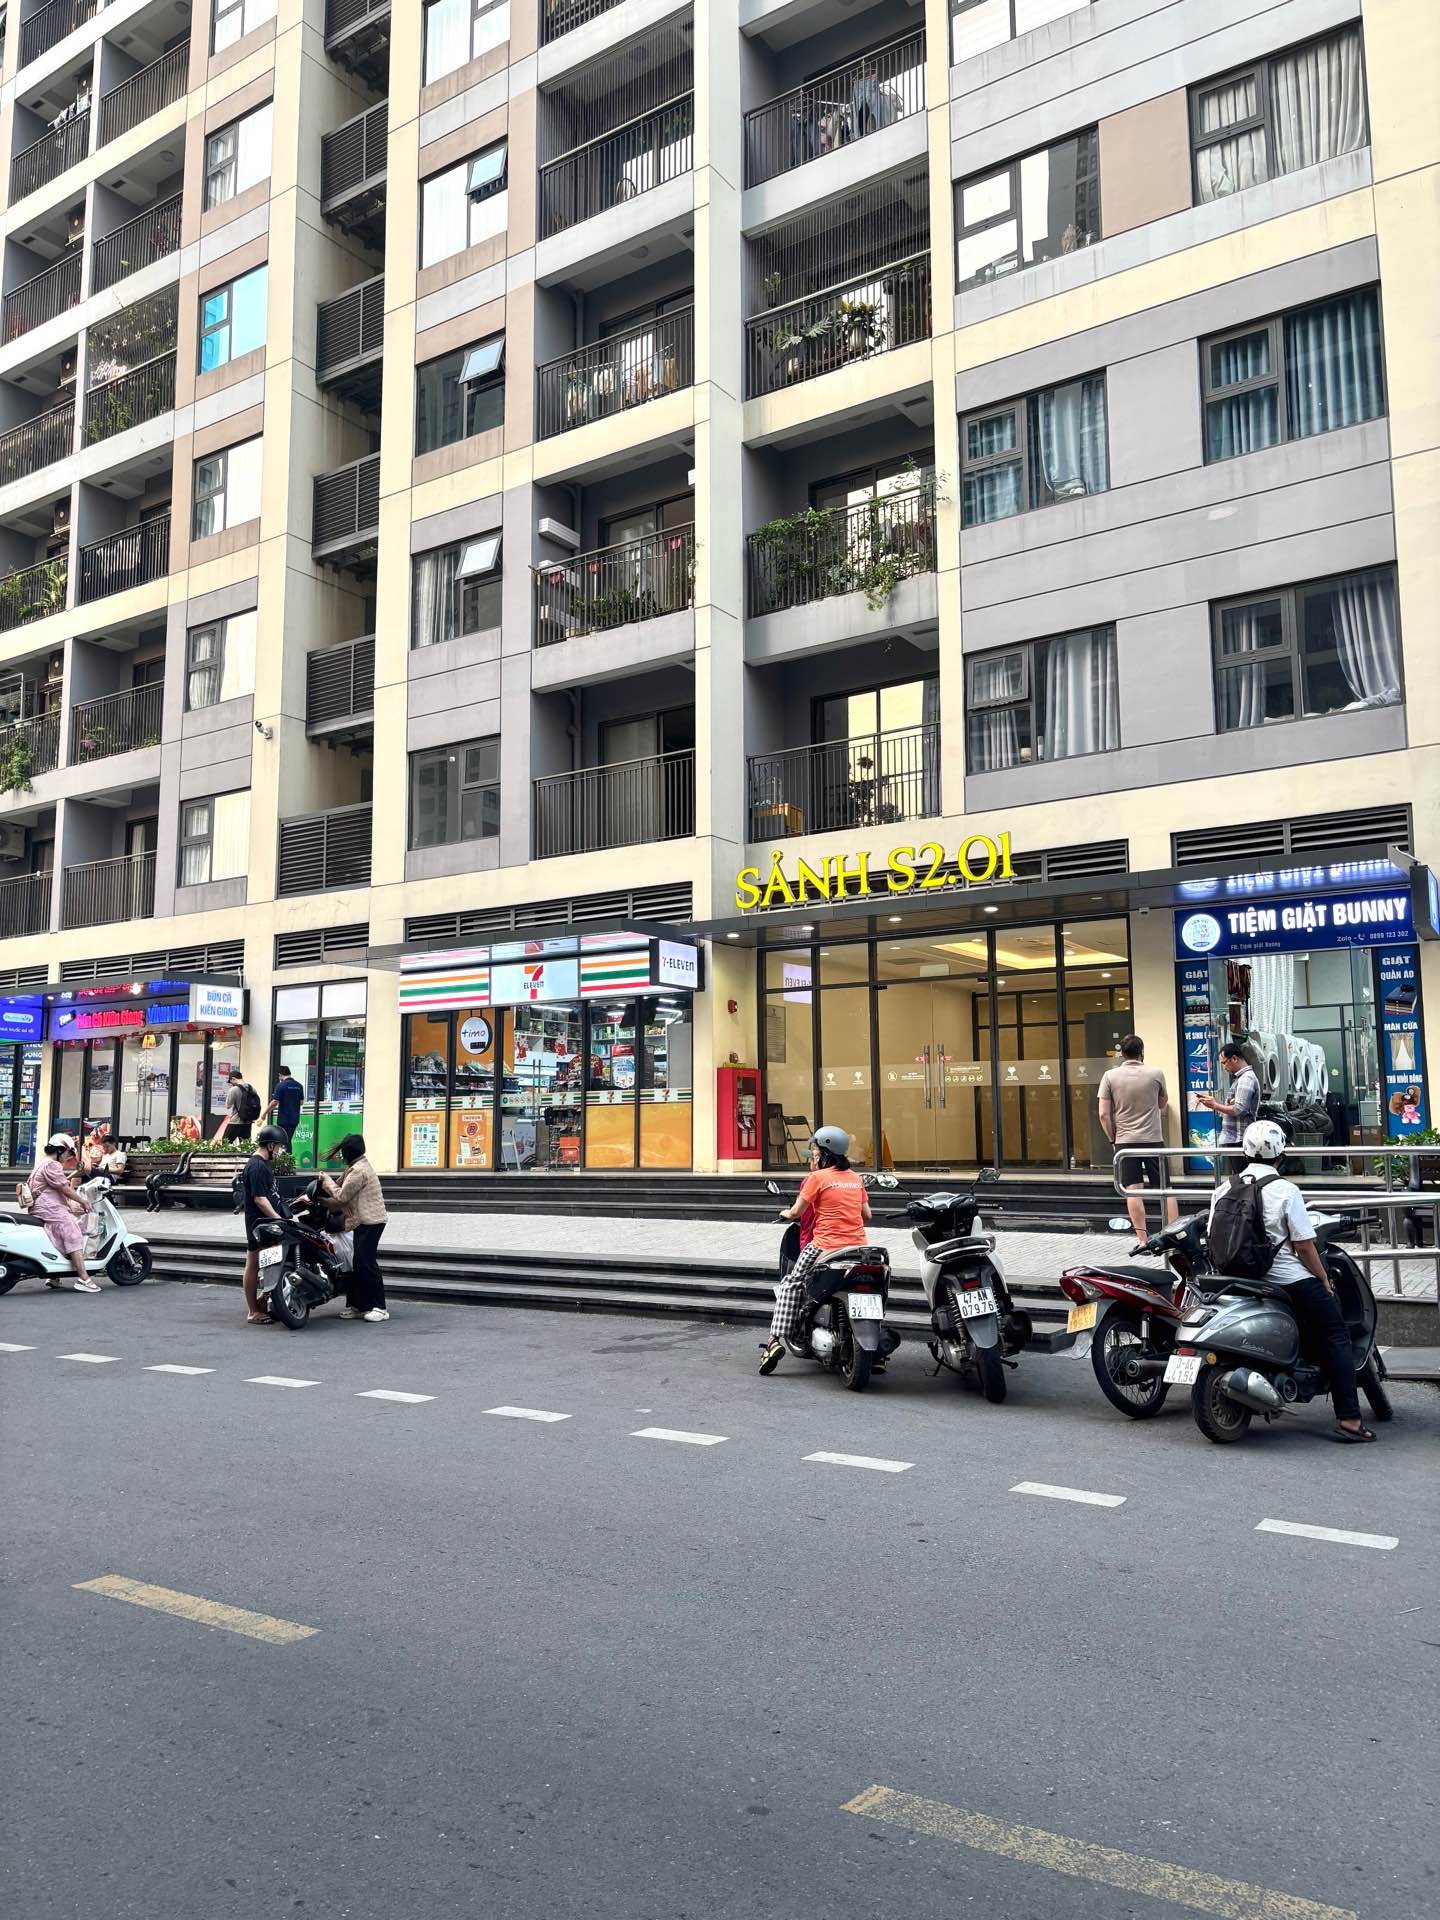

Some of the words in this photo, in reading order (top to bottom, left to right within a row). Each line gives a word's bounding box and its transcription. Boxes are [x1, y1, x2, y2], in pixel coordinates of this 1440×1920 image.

[735, 850, 872, 910] SẢNH
[887, 831, 1018, 892] S2.01
[1228, 907, 1276, 938] TIỆM
[1282, 902, 1328, 932] GIẶT
[1333, 897, 1407, 926] BUNNY
[962, 1300, 994, 1317] 079.76
[963, 1289, 988, 1304] 47-AN
